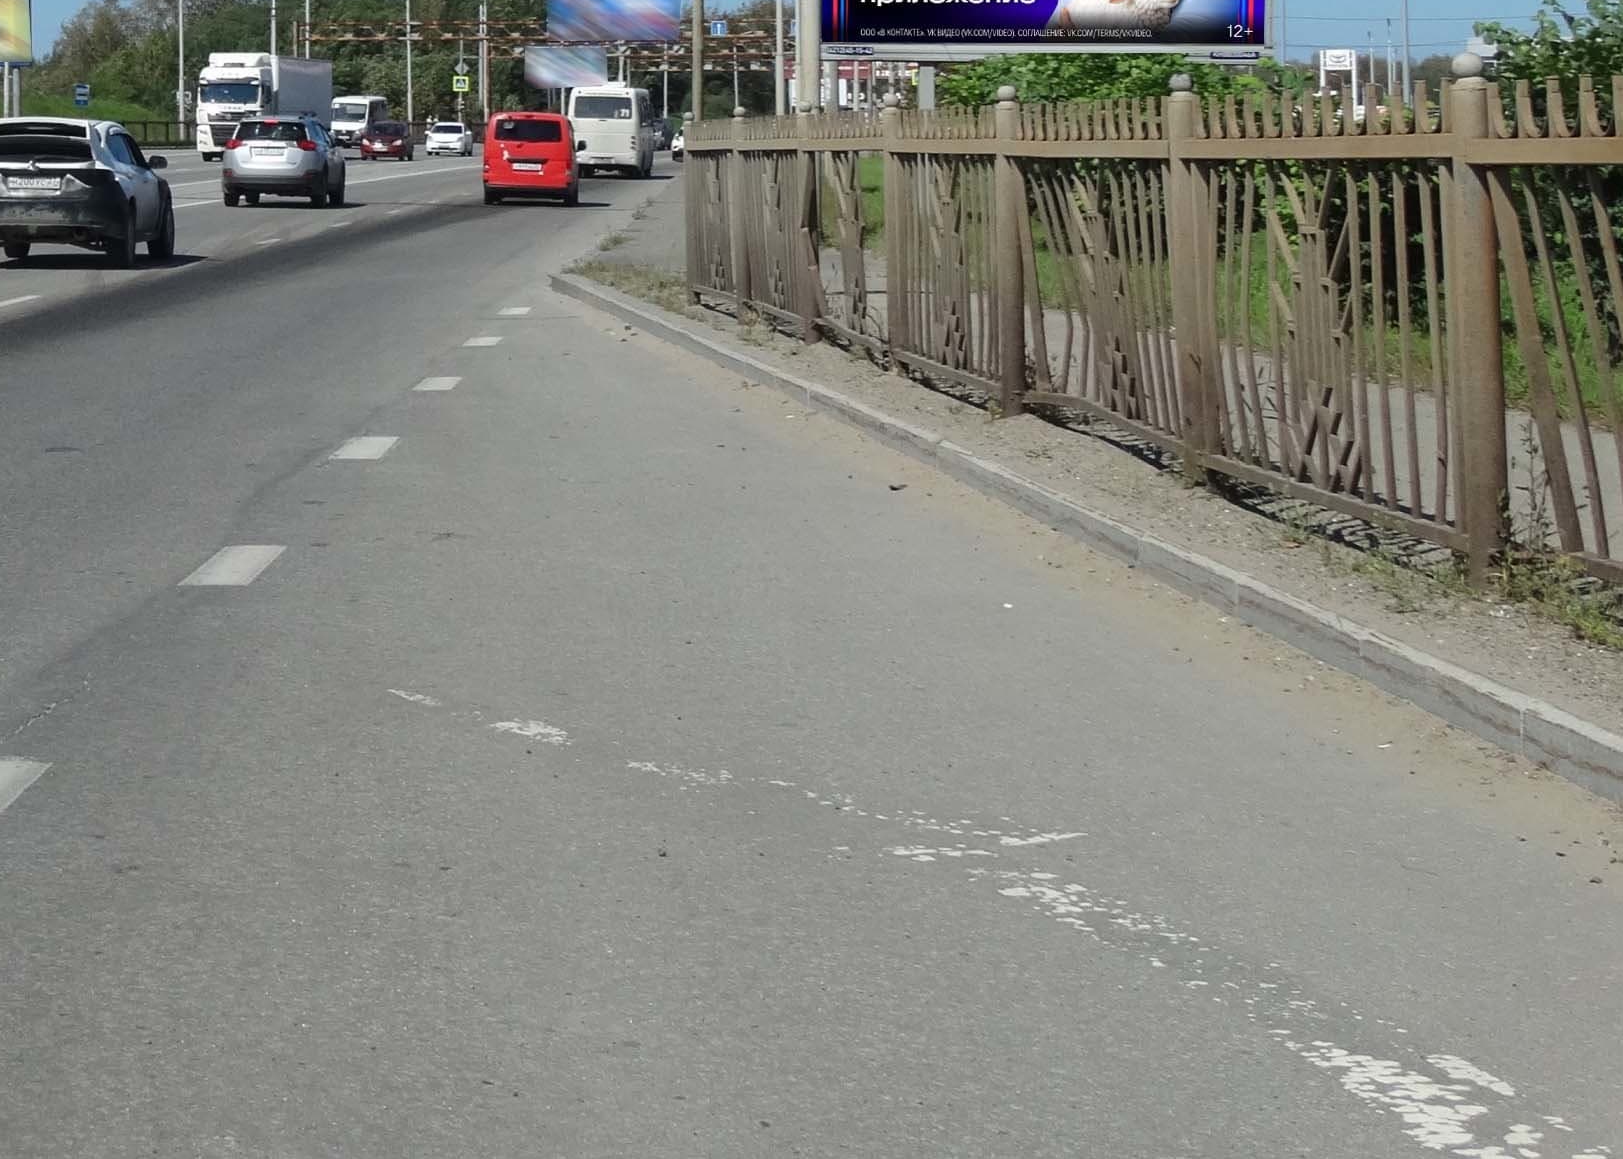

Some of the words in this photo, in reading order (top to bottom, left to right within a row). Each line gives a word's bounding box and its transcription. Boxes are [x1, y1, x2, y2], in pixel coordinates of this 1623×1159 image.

[860, 28, 876, 37] ООО
[937, 28, 961, 38] ВИДЕО
[1017, 28, 1066, 38] СОГЛАШЕНИЕ:
[1227, 24, 1254, 38] 12+
